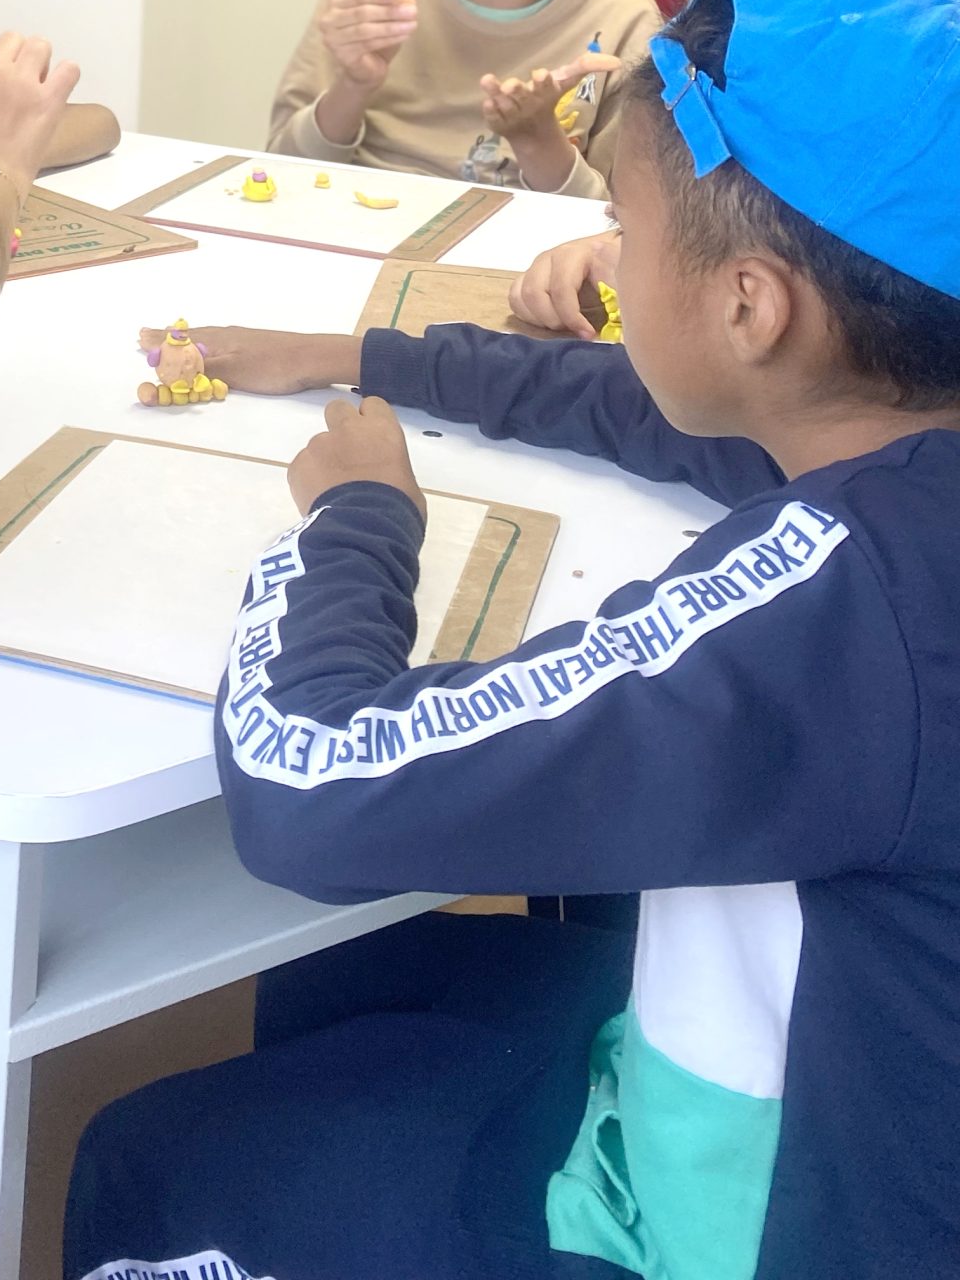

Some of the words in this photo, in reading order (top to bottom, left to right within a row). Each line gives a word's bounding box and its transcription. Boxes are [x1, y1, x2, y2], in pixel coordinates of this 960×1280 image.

[666, 521, 818, 624] EXPLORE
[528, 623, 628, 707] GREAT
[613, 605, 684, 666] THE
[411, 673, 525, 743] NORTH
